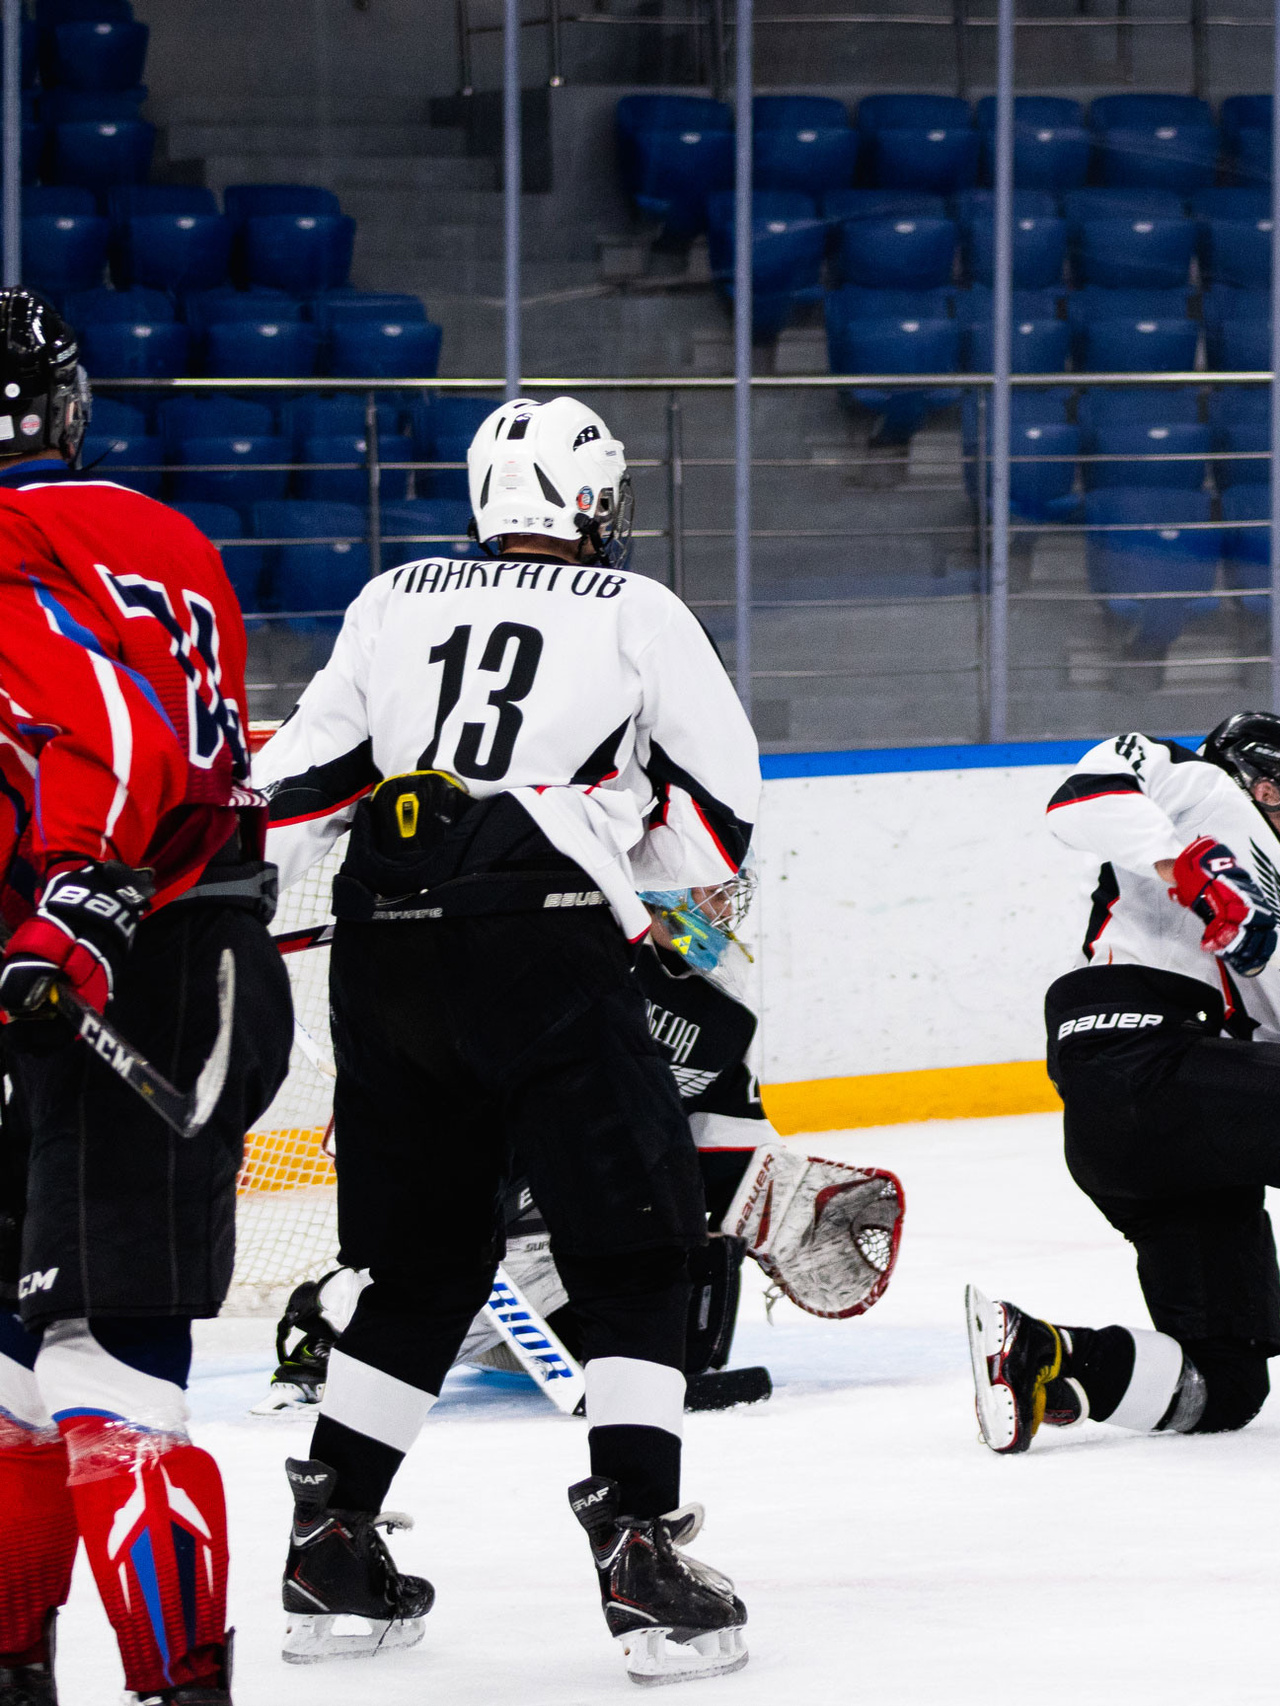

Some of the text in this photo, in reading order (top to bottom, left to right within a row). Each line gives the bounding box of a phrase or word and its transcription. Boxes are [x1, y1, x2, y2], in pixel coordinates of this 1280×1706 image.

[416, 621, 544, 782] 13
[80, 1013, 134, 1078] CCM
[1058, 1013, 1164, 1041] BAUER
